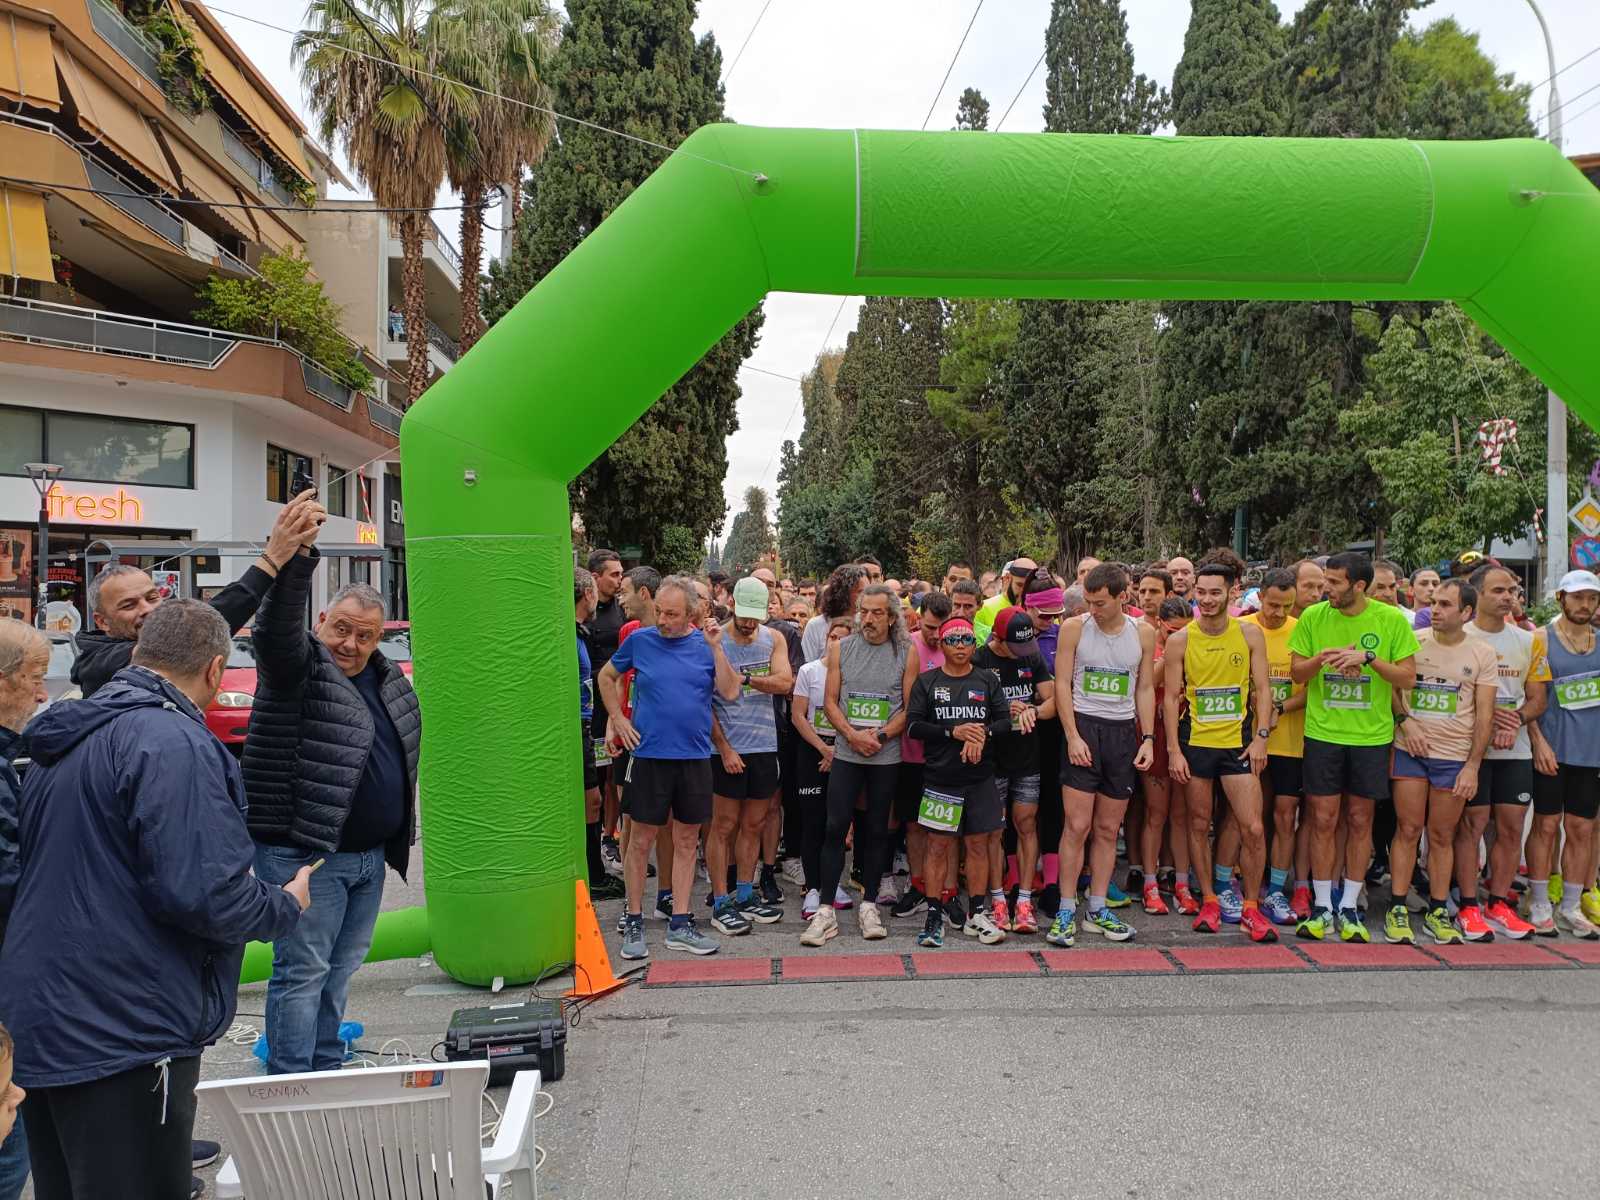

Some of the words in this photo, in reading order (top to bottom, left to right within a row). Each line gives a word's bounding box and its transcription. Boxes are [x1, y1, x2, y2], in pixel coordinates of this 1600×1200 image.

[47, 486, 140, 521] fresh
[1089, 676, 1120, 692] 546
[1330, 683, 1364, 700] 294
[1565, 682, 1599, 699] 622
[1204, 696, 1235, 712] 226
[1417, 692, 1449, 710] 295
[851, 702, 880, 717] 562
[935, 706, 986, 719] PILIPINAS
[798, 786, 822, 795] NIKE
[925, 801, 954, 821] 204
